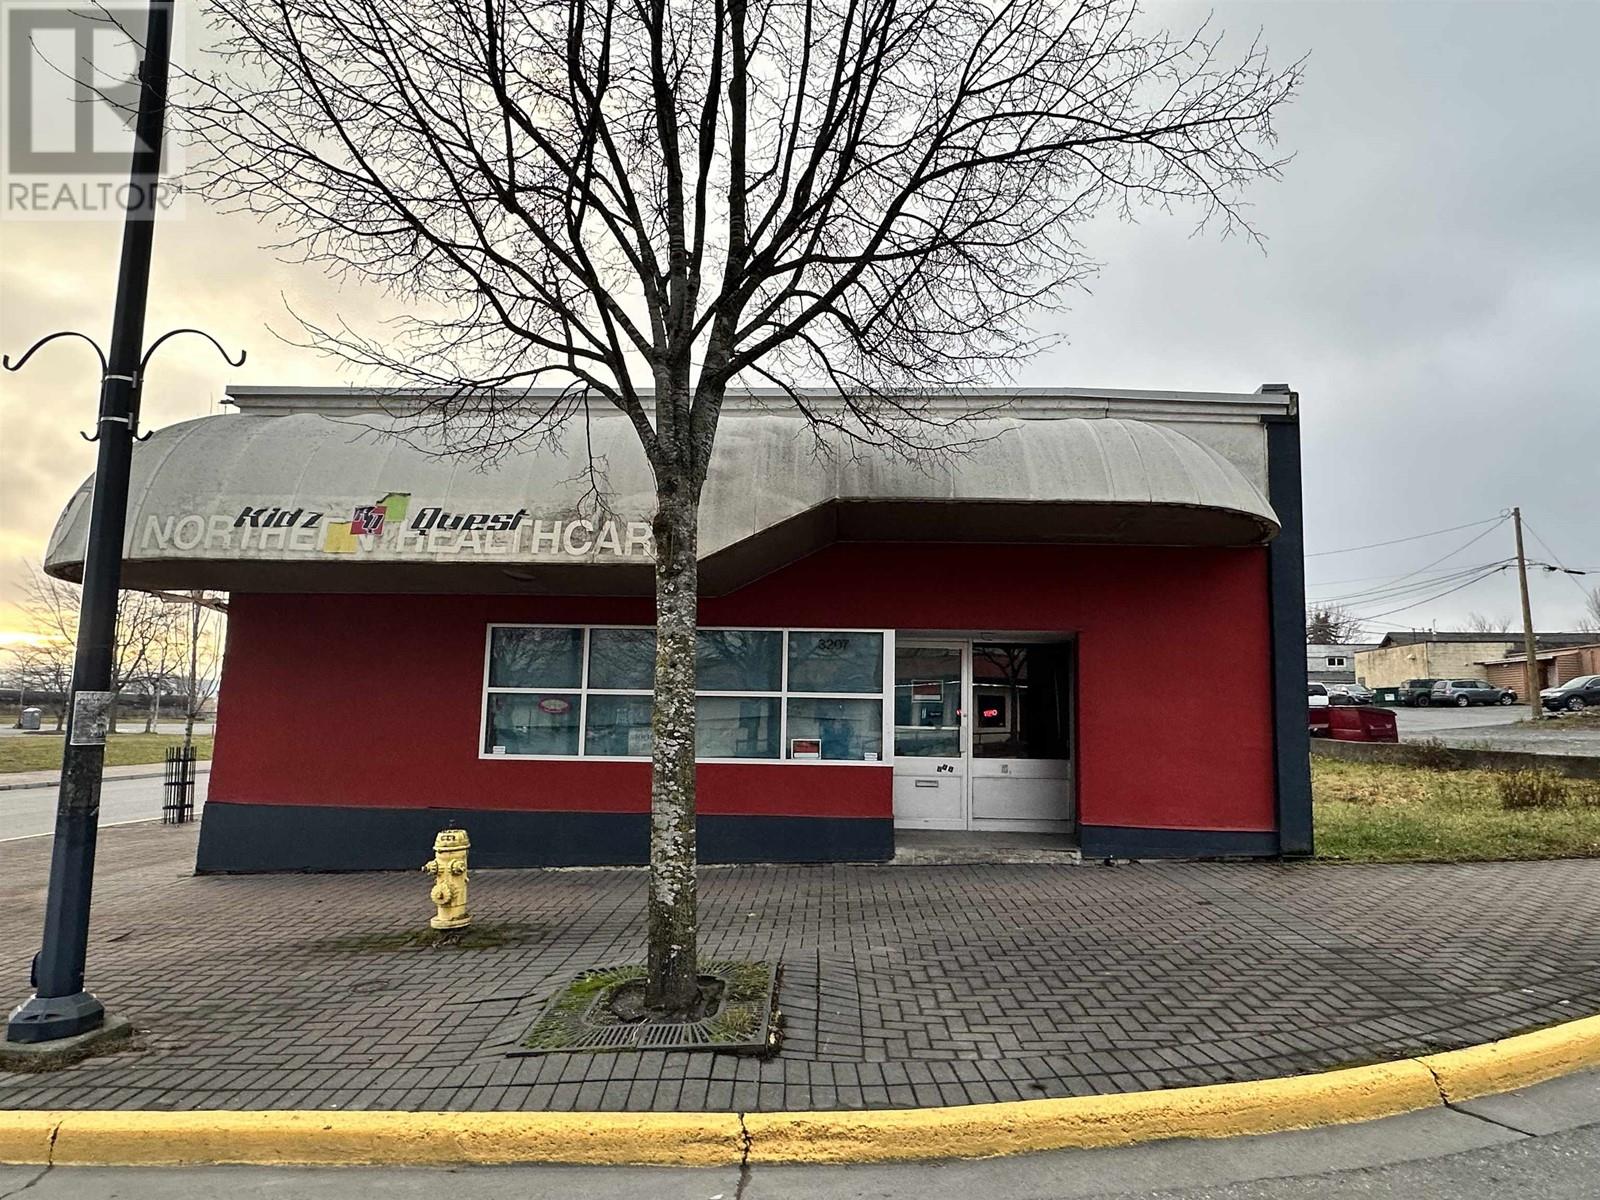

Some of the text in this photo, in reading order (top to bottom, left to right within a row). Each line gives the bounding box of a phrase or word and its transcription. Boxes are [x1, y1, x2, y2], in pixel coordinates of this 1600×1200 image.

[140, 514, 656, 556] NORTHE HEALTHCAR
[234, 506, 324, 528] Kidz
[411, 507, 530, 536] Quest
